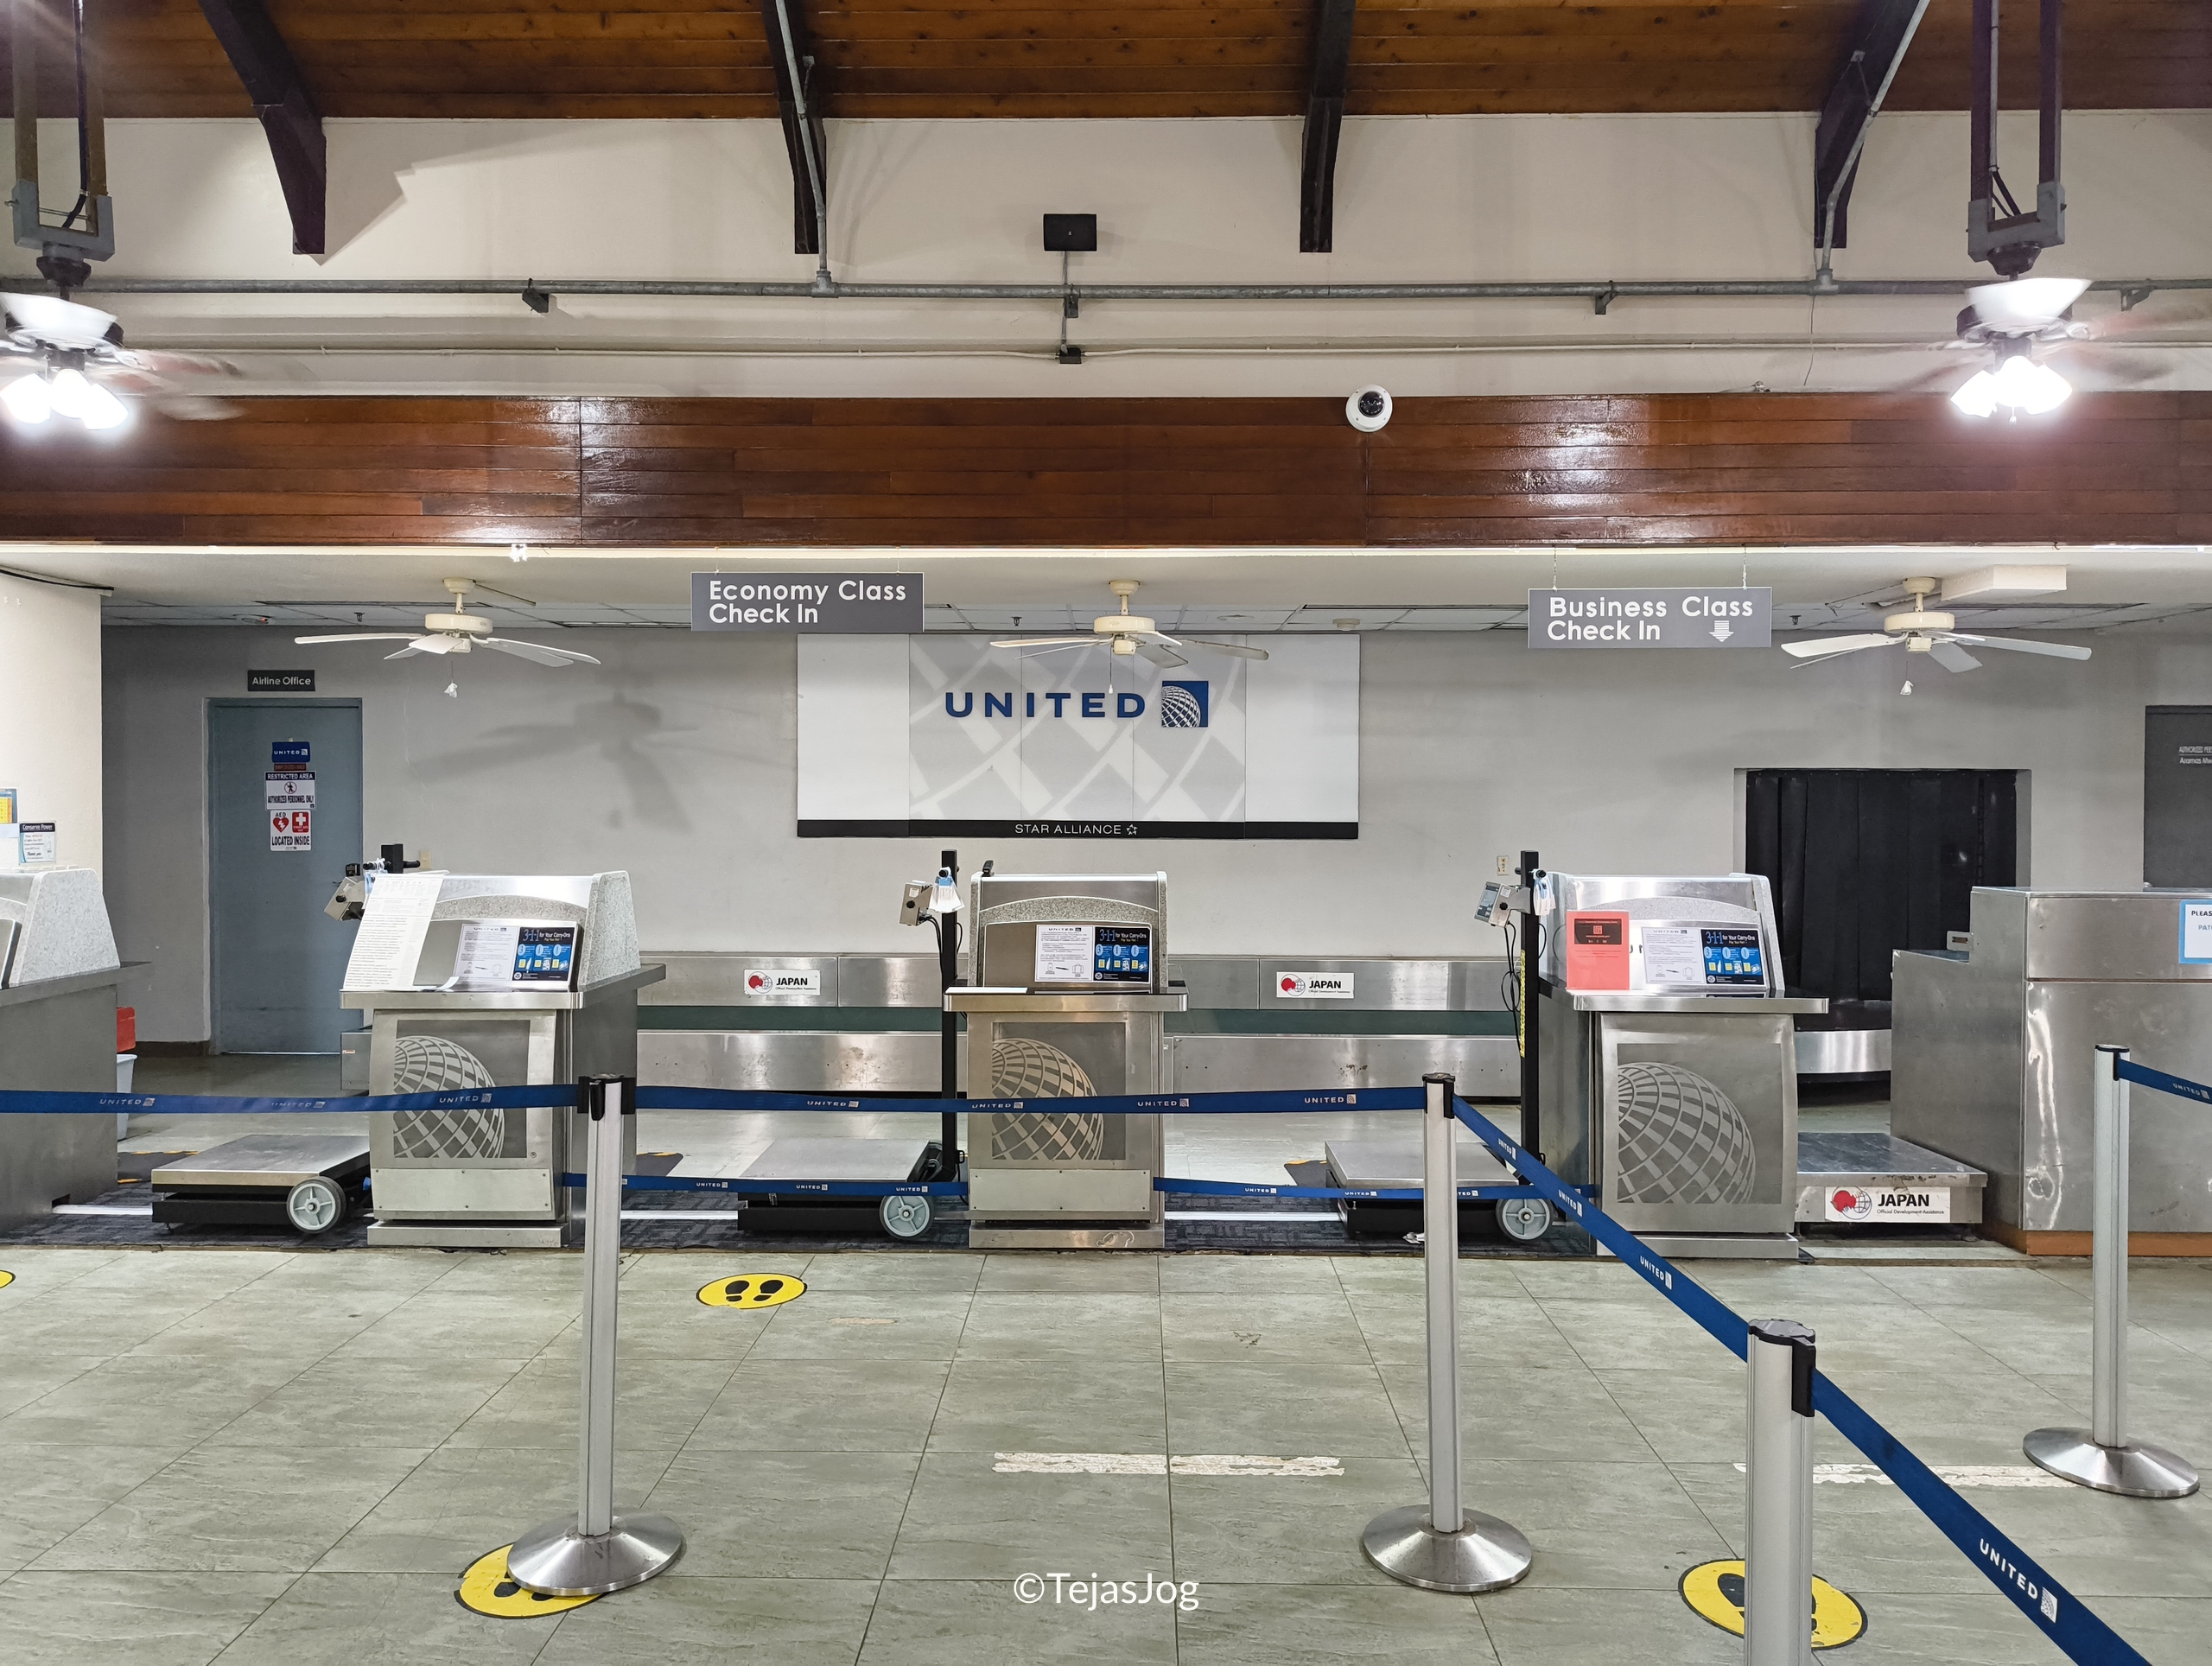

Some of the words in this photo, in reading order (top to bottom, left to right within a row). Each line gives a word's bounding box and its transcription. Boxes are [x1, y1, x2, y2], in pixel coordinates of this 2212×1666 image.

[709, 580, 829, 605] Economy
[838, 580, 906, 601] Class
[1549, 596, 1667, 617] Business
[1681, 595, 1753, 617] Class
[709, 603, 791, 624] Check
[798, 603, 818, 623] In
[1547, 620, 1631, 640] Check
[1638, 620, 1661, 640] In
[251, 677, 281, 685] Airline
[283, 677, 312, 685] Office
[945, 692, 1146, 718] UNITED
[1014, 823, 1050, 835] STAR
[1053, 823, 1122, 835] ALLIANCE
[272, 836, 293, 846] LOCATED
[295, 836, 310, 846] INSIDE
[523, 928, 540, 942] 3-1-1
[1099, 929, 1116, 942] 3-1-1
[1706, 931, 1724, 944] 3-1-1
[776, 977, 808, 986] JAPAN
[1309, 980, 1341, 989] JAPAN
[2172, 1083, 2201, 1096] UNITED
[439, 1095, 479, 1103] UNITED
[1878, 1193, 1929, 1206] JAPAN
[1497, 1138, 1512, 1155] UNITED
[1558, 1189, 1577, 1211] UNITED
[1640, 1255, 1664, 1281] UNITED
[1980, 1538, 2038, 1599] UNITED
